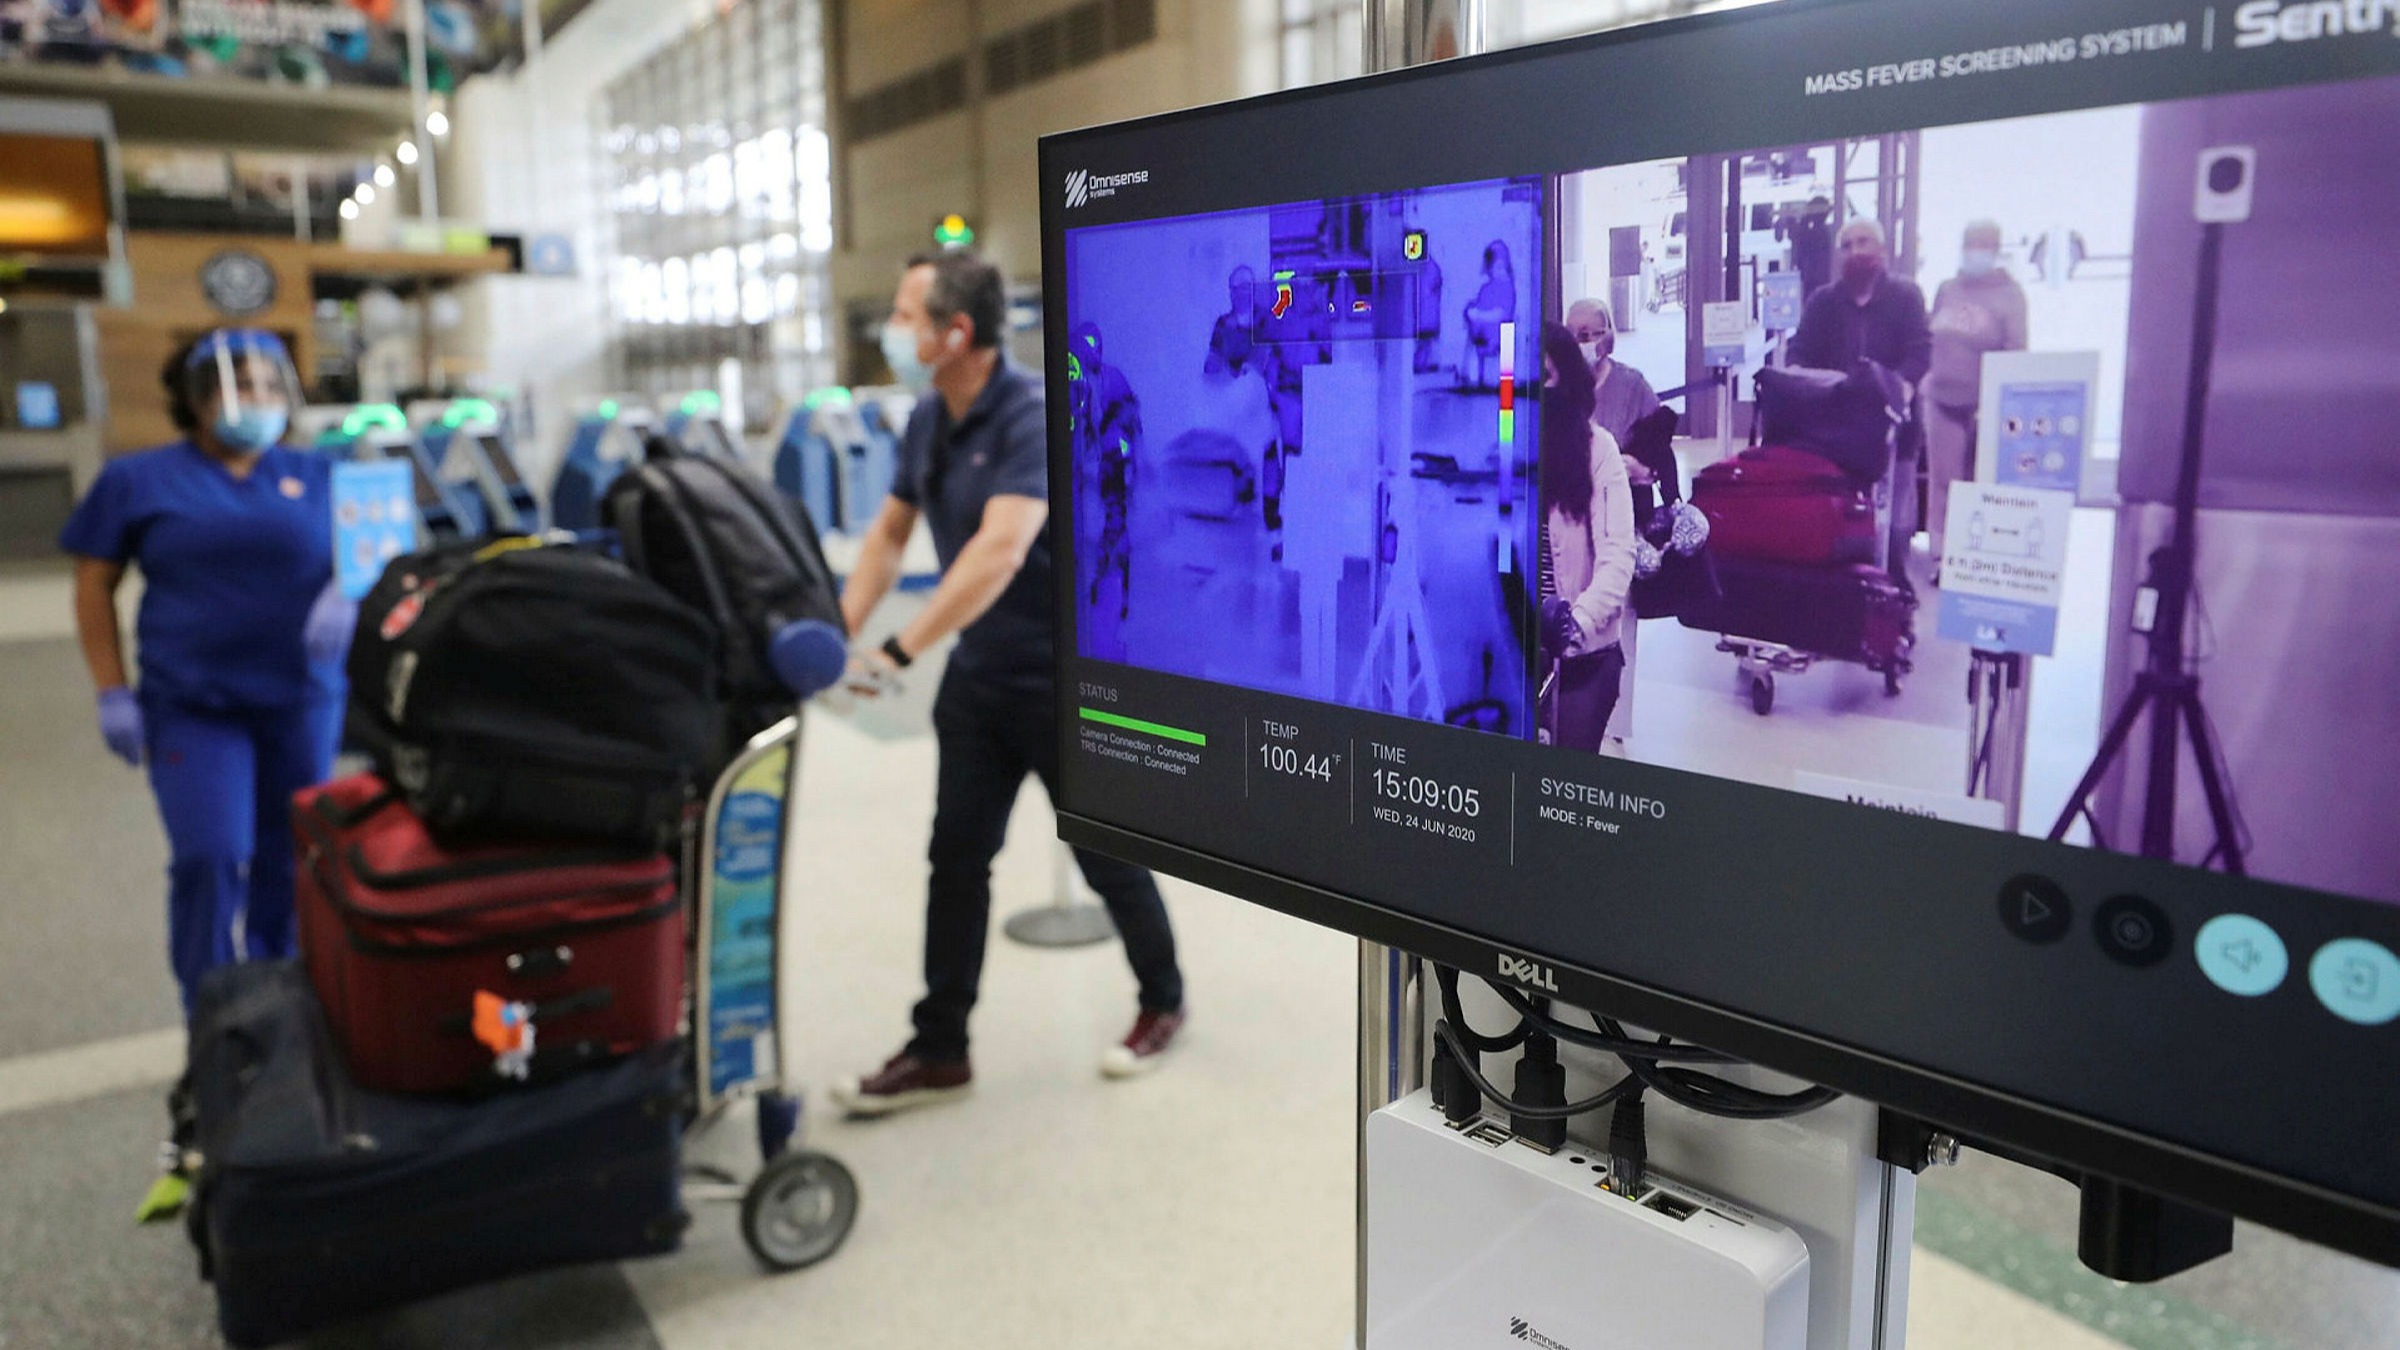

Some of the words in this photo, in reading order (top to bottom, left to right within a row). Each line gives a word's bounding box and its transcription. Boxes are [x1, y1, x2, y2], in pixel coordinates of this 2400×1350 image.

[2234, 0, 2400, 48] Sentr
[1804, 70, 1862, 95] MASS
[1866, 60, 1935, 87] FEVER
[1939, 38, 2076, 78] SCREENING
[2080, 21, 2186, 59] SYSTEM
[1089, 170, 1149, 190] Omnisense
[1078, 682, 1118, 702] STATUS
[1080, 725, 1108, 742] Camera
[1109, 732, 1151, 752] Connection
[1157, 744, 1200, 764] Connected
[1263, 720, 1299, 741] TEMP
[1081, 740, 1097, 753] TRS
[1098, 744, 1139, 763] Connection
[1144, 754, 1187, 775] Connected
[1260, 743, 1332, 782] 100.44
[1371, 742, 1406, 764] TIME
[1372, 768, 1480, 817] 15:09:05
[1540, 777, 1614, 808] SYSTEM
[1620, 794, 1666, 819] INFO
[1373, 806, 1403, 827] WED,
[1405, 813, 1419, 828] 24
[1421, 818, 1445, 834] JUN
[1448, 824, 1476, 842] 2020
[1539, 805, 1577, 826] MODE
[1586, 815, 1620, 834] Fever
[1498, 953, 1559, 992] DELL
[1529, 1327, 1571, 1350] Omnise
